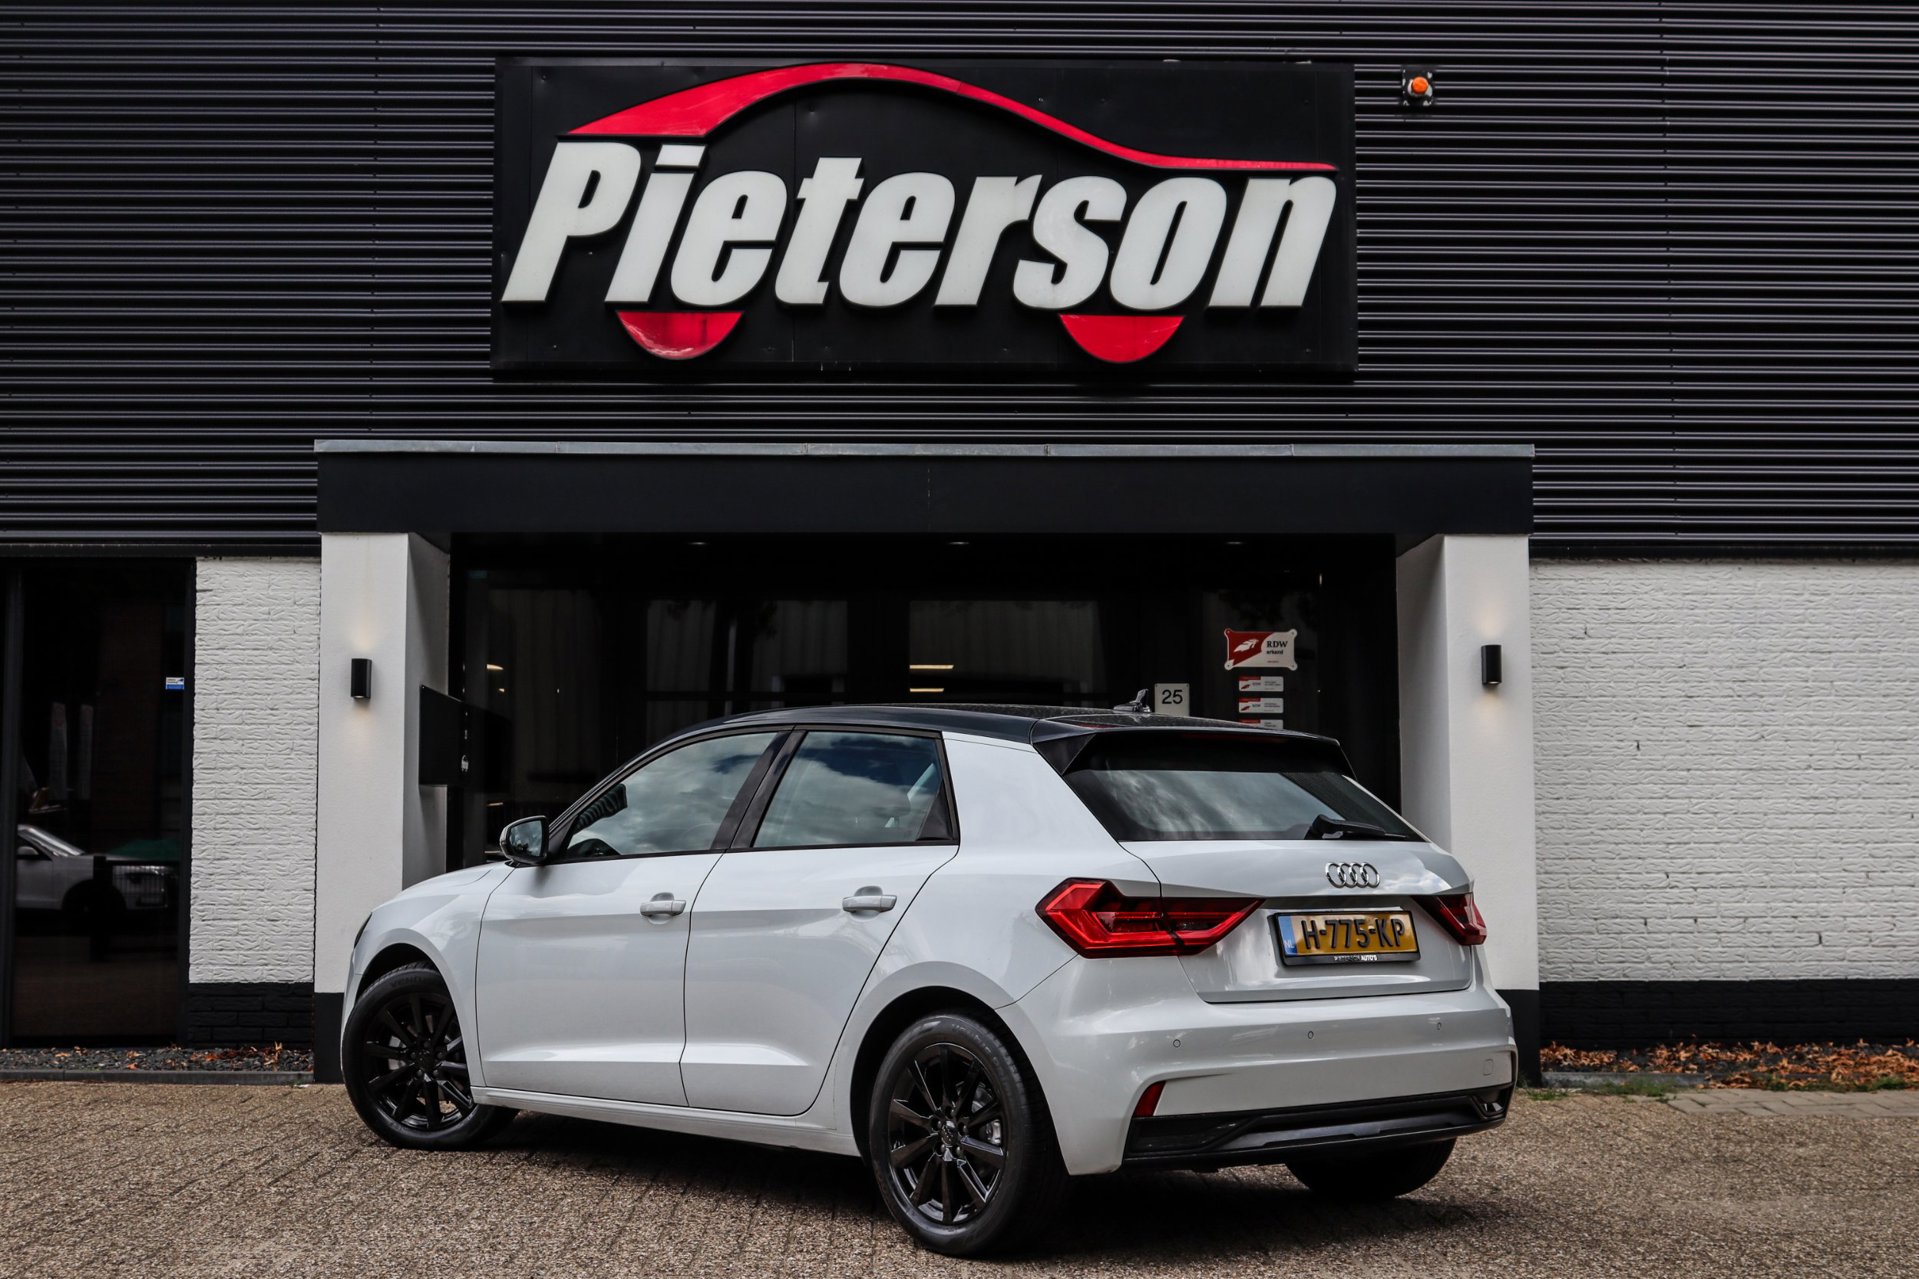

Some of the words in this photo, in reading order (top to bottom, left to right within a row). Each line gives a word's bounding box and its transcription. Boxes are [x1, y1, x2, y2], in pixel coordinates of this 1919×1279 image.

[501, 142, 1337, 310] Pieterson
[1266, 640, 1288, 648] RDW
[1161, 689, 1183, 705] 25
[1301, 918, 1405, 950] H-775-KP
